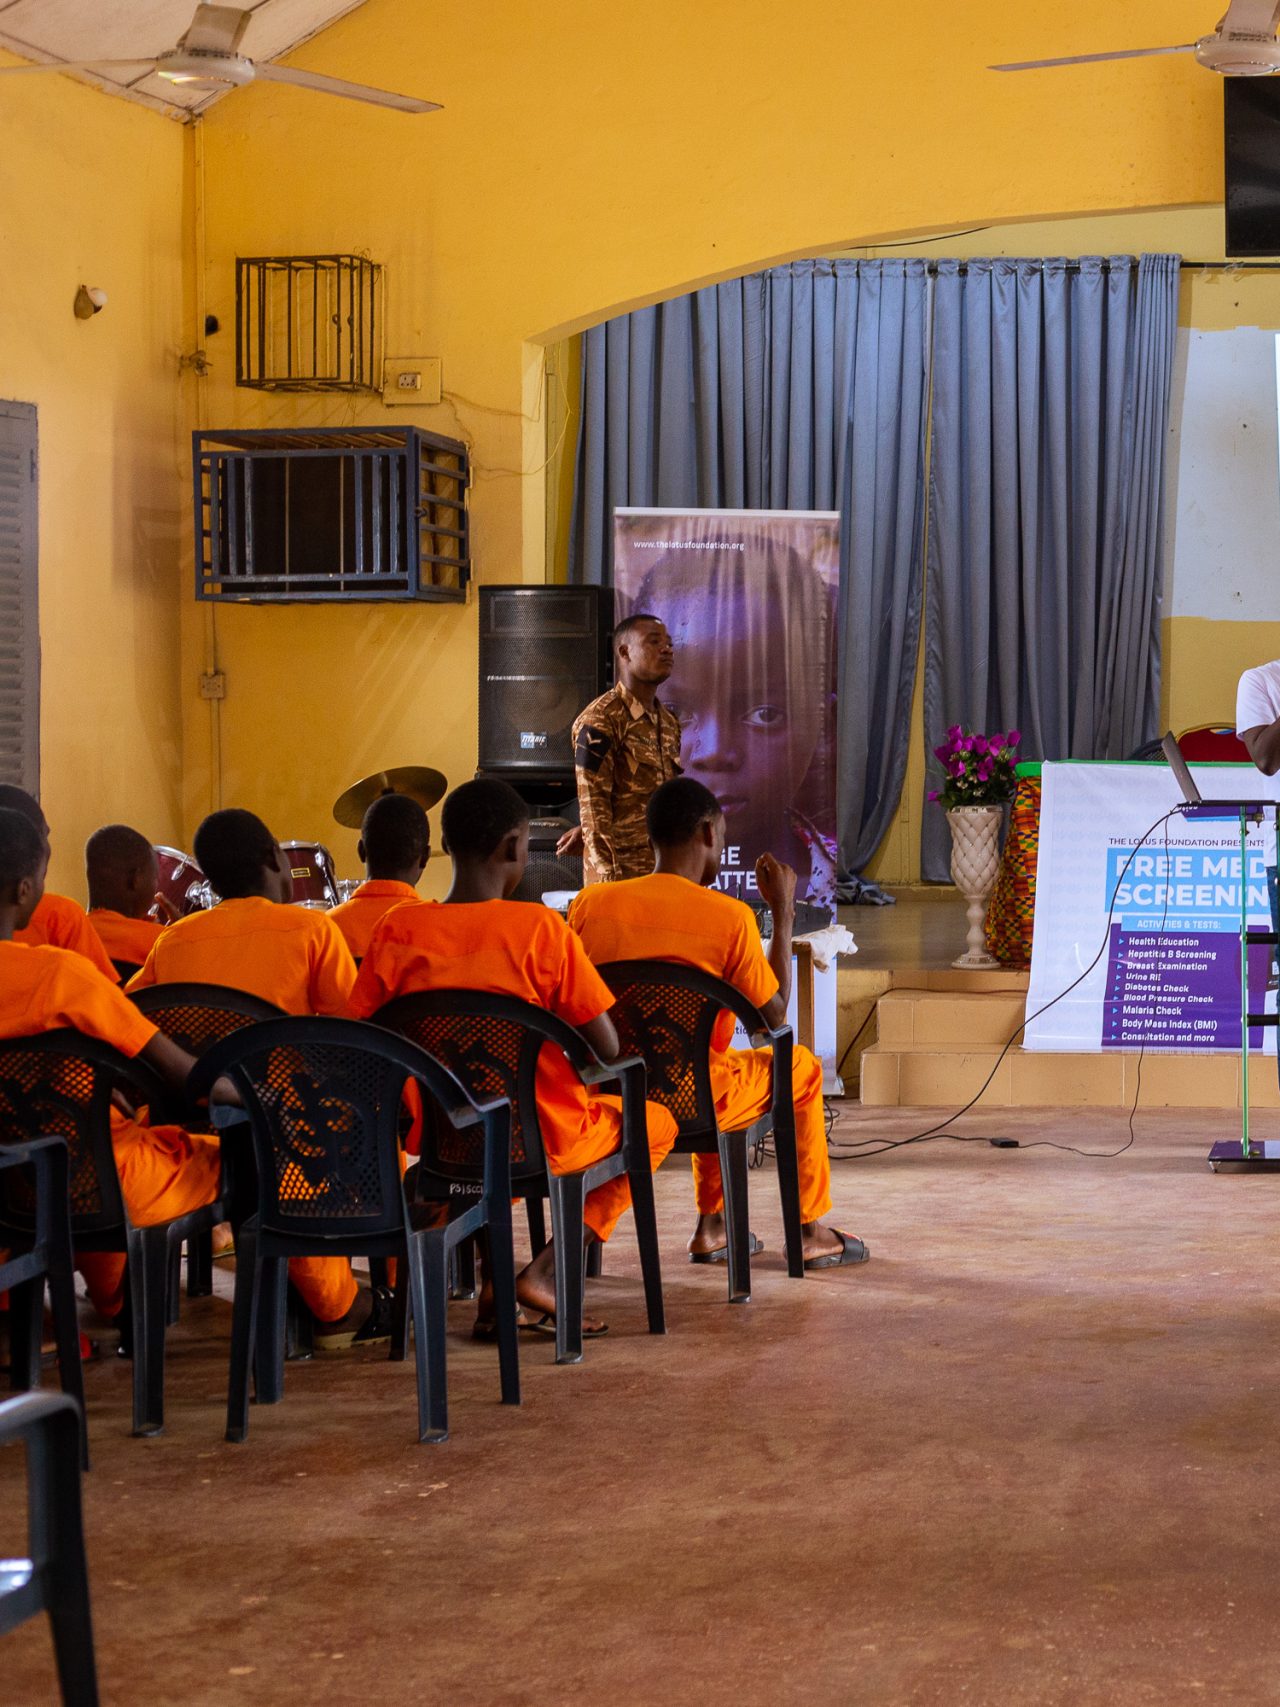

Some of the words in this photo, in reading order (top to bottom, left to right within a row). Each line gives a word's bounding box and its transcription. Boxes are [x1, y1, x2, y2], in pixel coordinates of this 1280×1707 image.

[634, 541, 745, 551] www.thelotusfoundation.org
[1128, 838, 1157, 846] LOTUS
[1159, 838, 1219, 847] FOUNDATION
[1116, 855, 1193, 877] FREE
[1202, 856, 1266, 878] MED
[1114, 883, 1270, 906] SCREENIN
[1193, 921, 1221, 929] TESTS:
[1129, 937, 1156, 946] Health
[1158, 937, 1199, 946] Education
[1128, 950, 1166, 959] Hepatitis
[1168, 950, 1174, 958] B
[1175, 950, 1217, 960] Screening
[1127, 962, 1154, 970] Breast
[1158, 962, 1208, 971] Examination
[1126, 973, 1148, 981] Urine
[1125, 983, 1161, 992] Diabetes
[1163, 984, 1189, 993] Check
[1123, 994, 1147, 1002] Blood
[1148, 994, 1185, 1003] Pressure
[1188, 995, 1214, 1003] Check
[1122, 1005, 1154, 1015] Malaria
[1156, 1006, 1182, 1015] Check
[1122, 1019, 1142, 1029] Body
[1144, 1019, 1167, 1028] Mass
[1169, 1020, 1192, 1029] Index
[1194, 1020, 1218, 1031] (BMI)
[1122, 1032, 1175, 1041] Consultation
[1177, 1033, 1192, 1042] and
[1194, 1034, 1215, 1042] more
